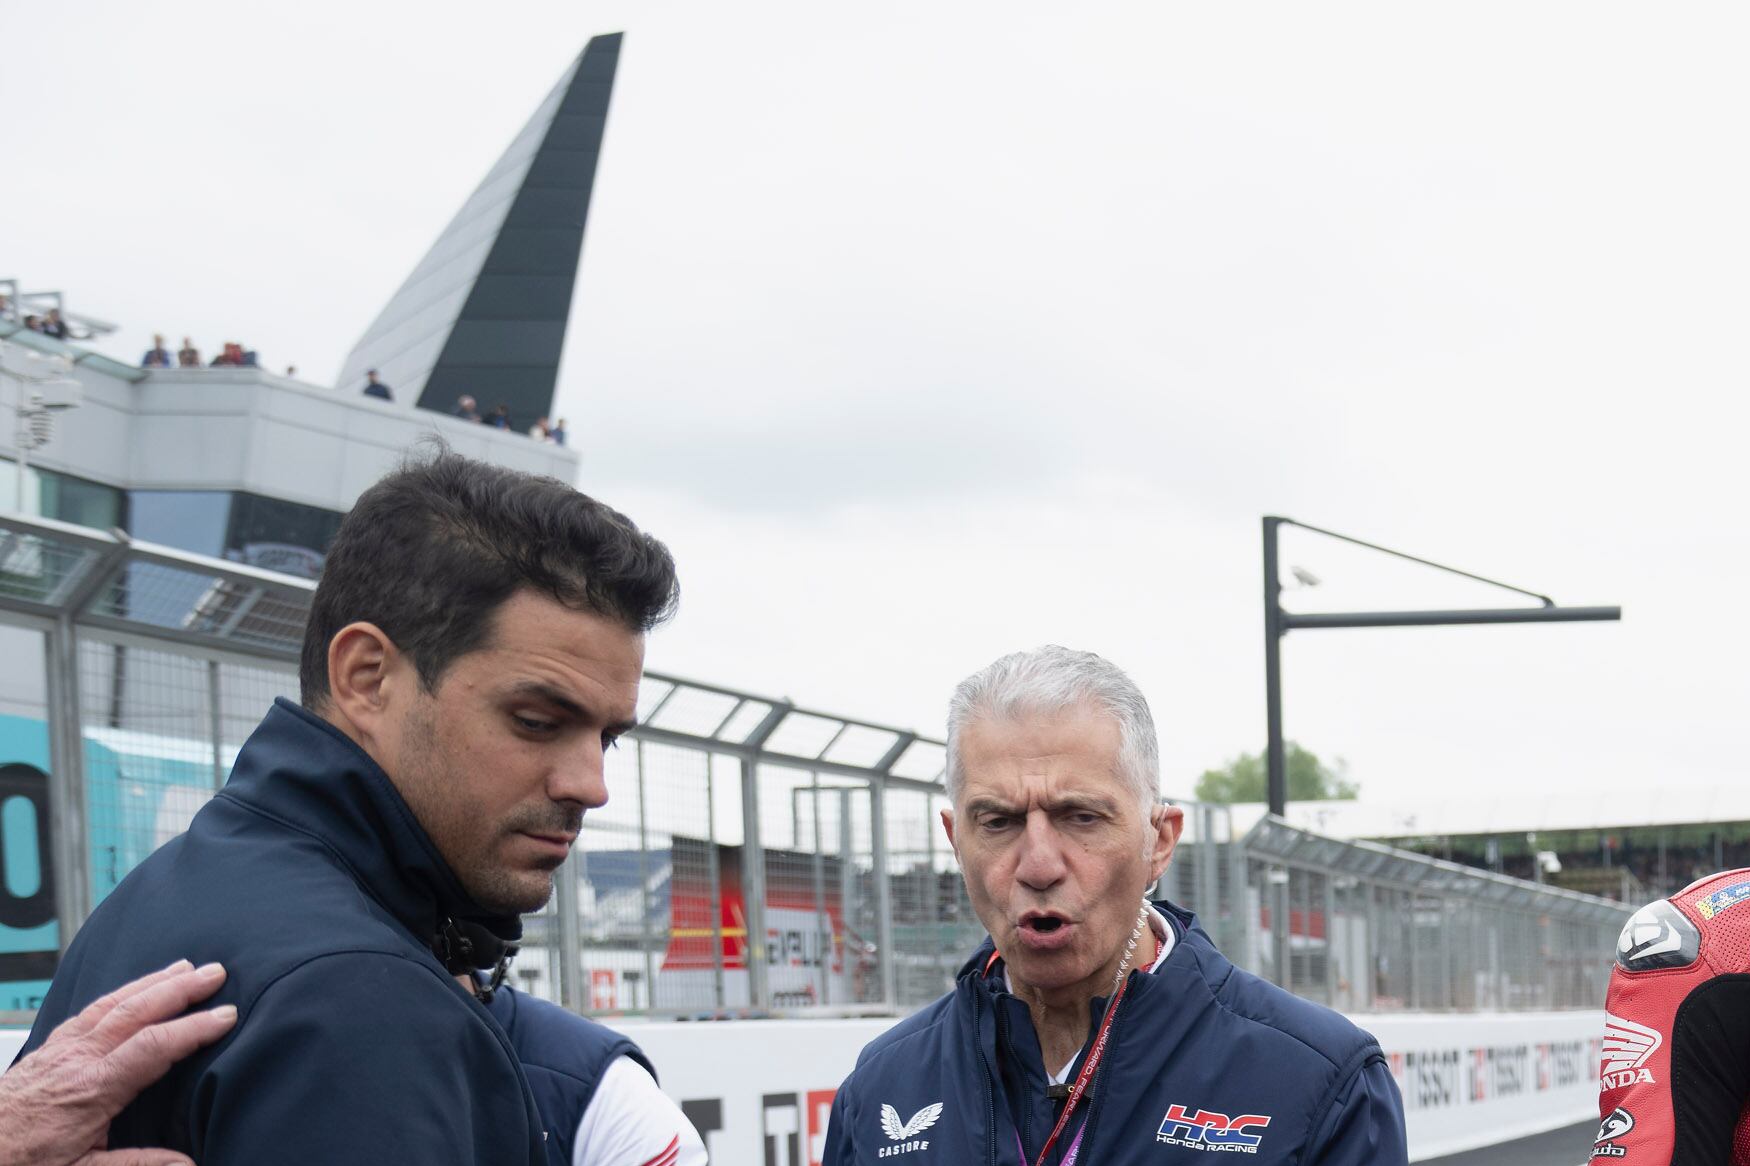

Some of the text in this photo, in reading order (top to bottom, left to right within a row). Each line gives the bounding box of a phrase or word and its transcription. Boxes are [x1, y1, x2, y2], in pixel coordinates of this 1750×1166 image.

[1157, 1103, 1272, 1147] HRC
[878, 1140, 930, 1158] CASTORE
[1156, 1134, 1258, 1154] Honda RACING
